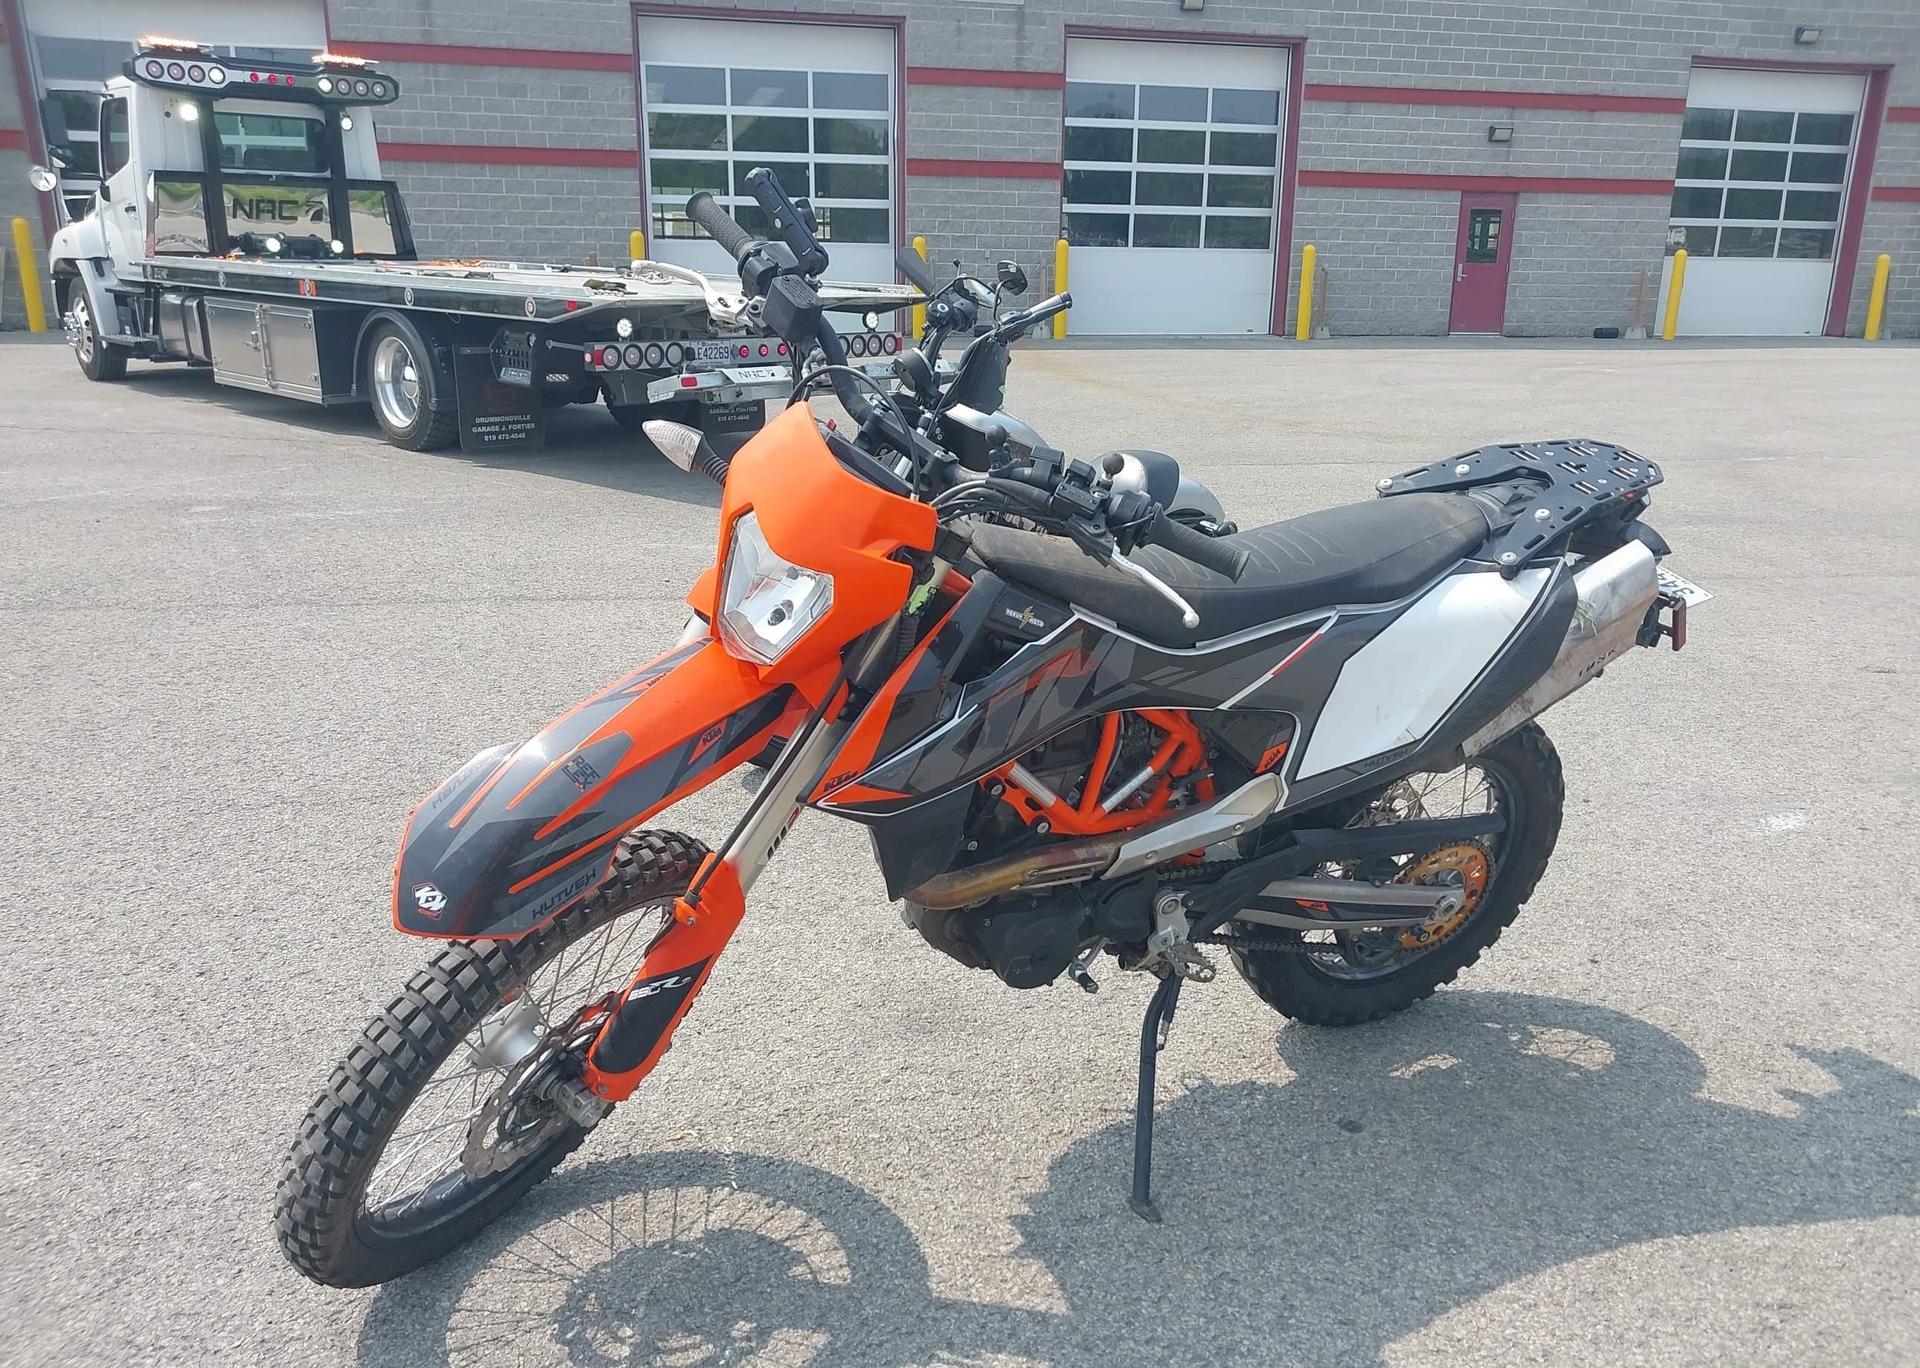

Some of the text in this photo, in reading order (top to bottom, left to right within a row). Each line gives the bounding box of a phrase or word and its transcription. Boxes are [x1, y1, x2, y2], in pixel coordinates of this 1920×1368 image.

[693, 346, 730, 360] E42269
[475, 414, 531, 424] DRUMMONDVILLE
[472, 425, 500, 433] GARAGE
[508, 423, 535, 431] FORTIER
